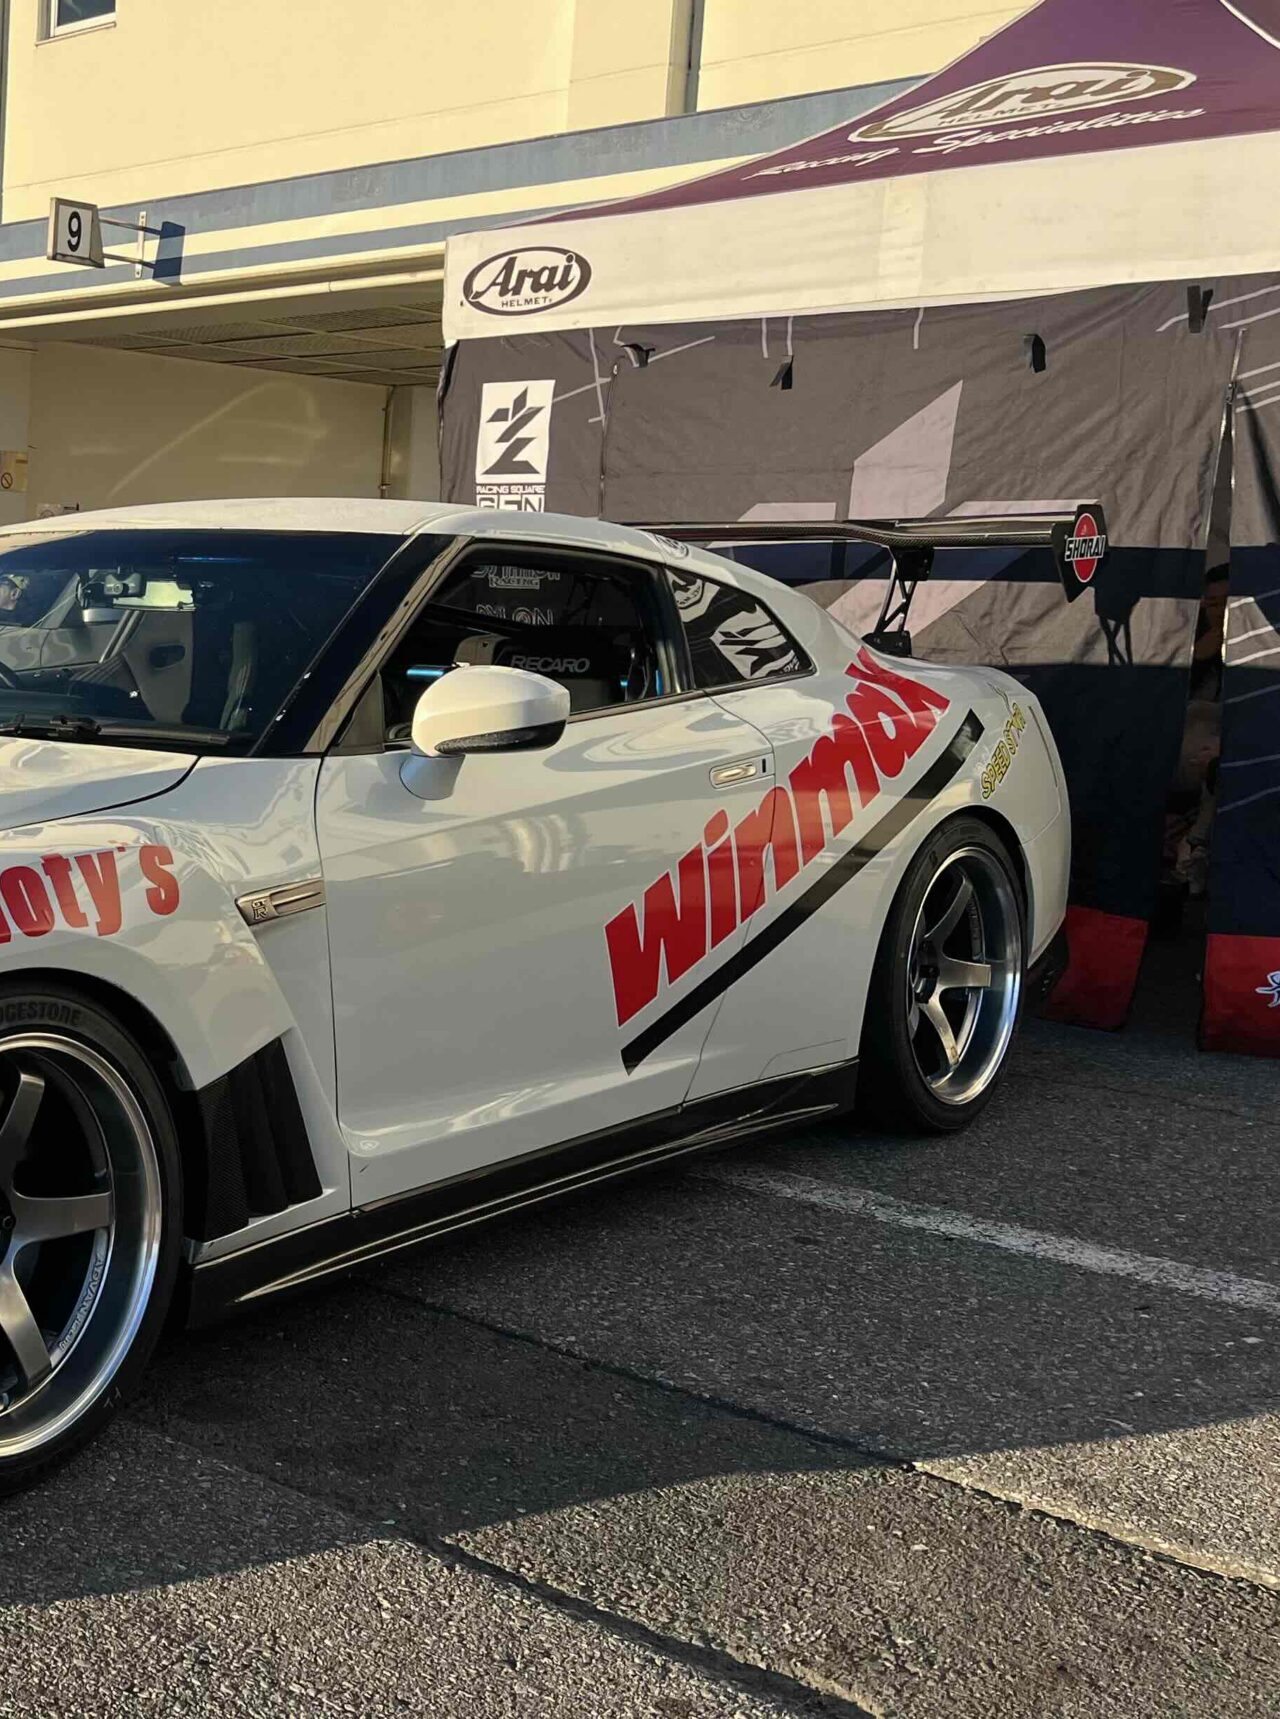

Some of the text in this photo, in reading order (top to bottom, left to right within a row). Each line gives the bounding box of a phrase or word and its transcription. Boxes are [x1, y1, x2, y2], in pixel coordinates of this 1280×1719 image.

[883, 71, 1152, 131] Arai
[67, 210, 83, 252] 9
[470, 254, 576, 301] Arai
[501, 296, 551, 308] HELMET
[476, 485, 546, 495] RACING SQUARE
[1065, 536, 1105, 561] SHORAI
[511, 656, 590, 673] RECARO
